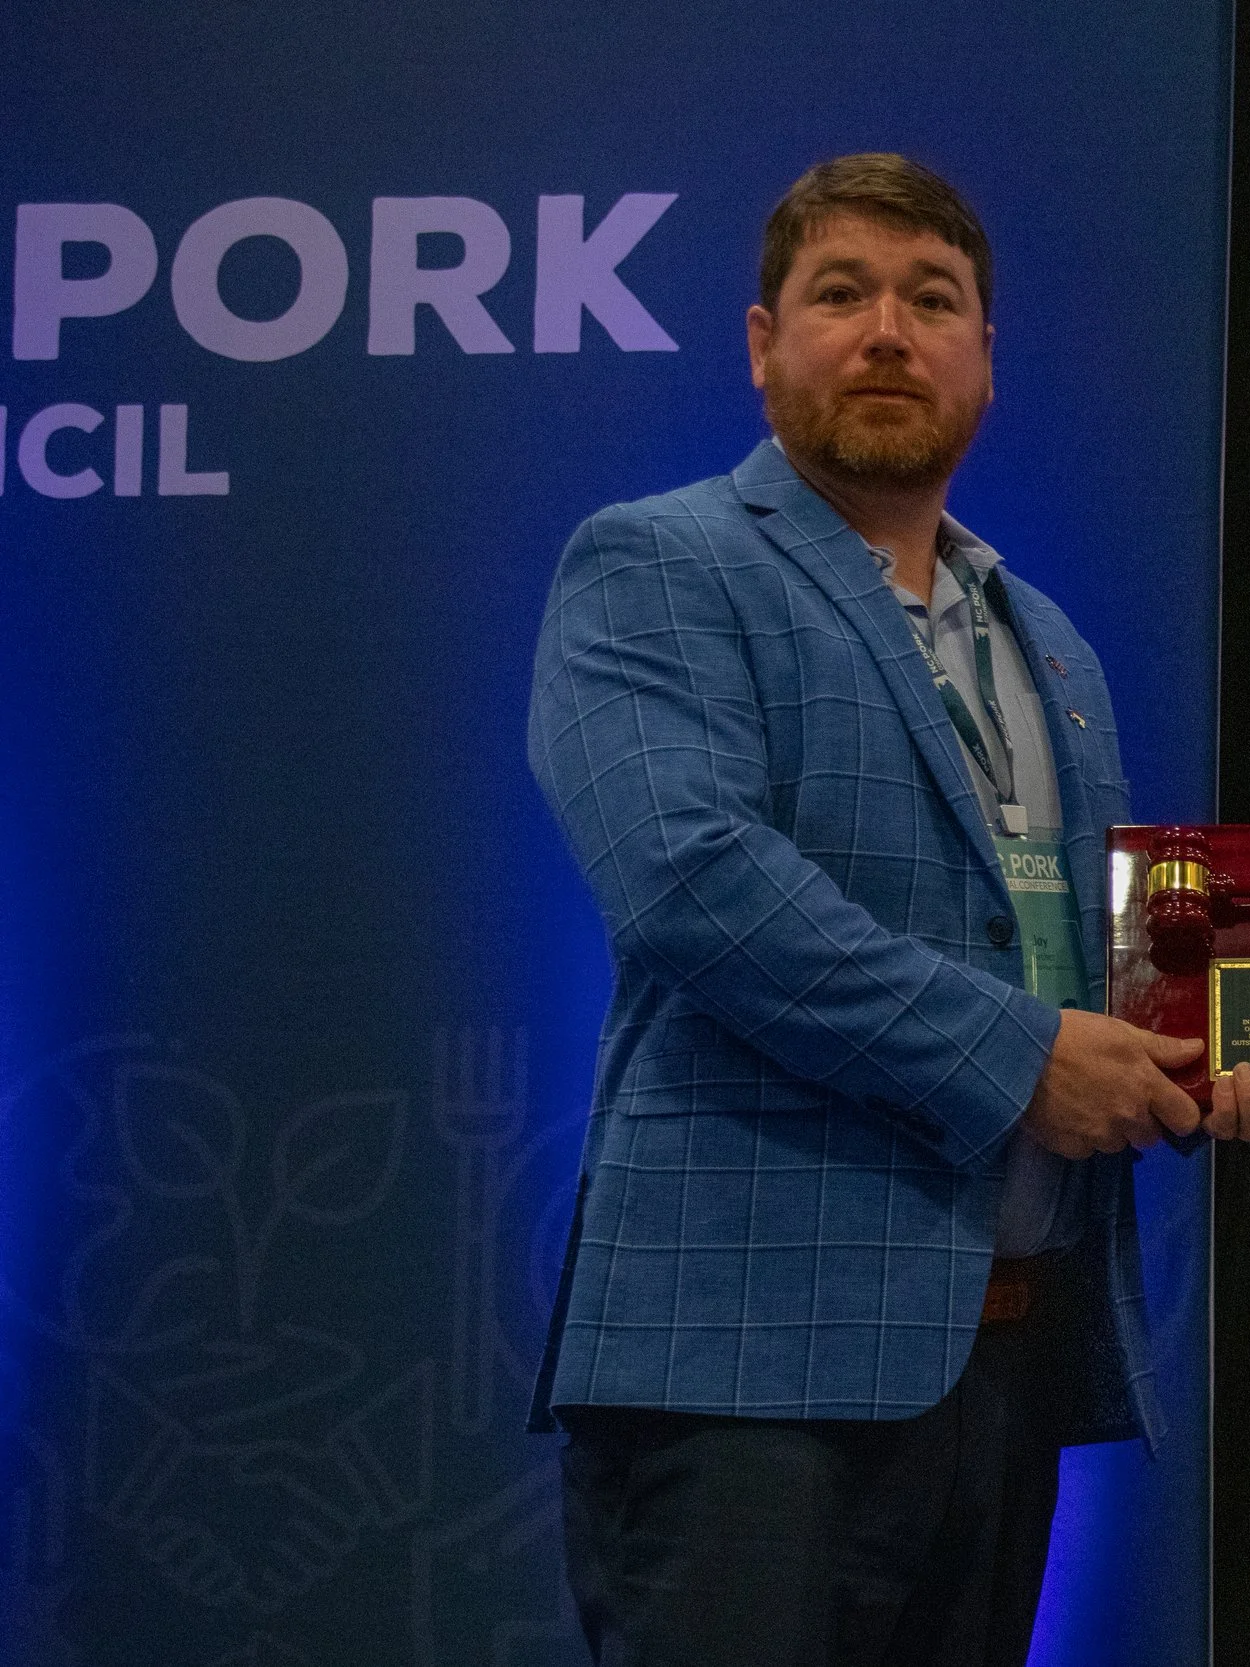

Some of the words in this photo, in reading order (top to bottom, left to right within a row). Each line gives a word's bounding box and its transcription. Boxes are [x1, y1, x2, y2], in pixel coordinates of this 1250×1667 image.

[13, 193, 680, 362] PORK
[0, 403, 229, 499] CIL
[912, 633, 930, 659] PORK
[1009, 853, 1062, 878] PORK
